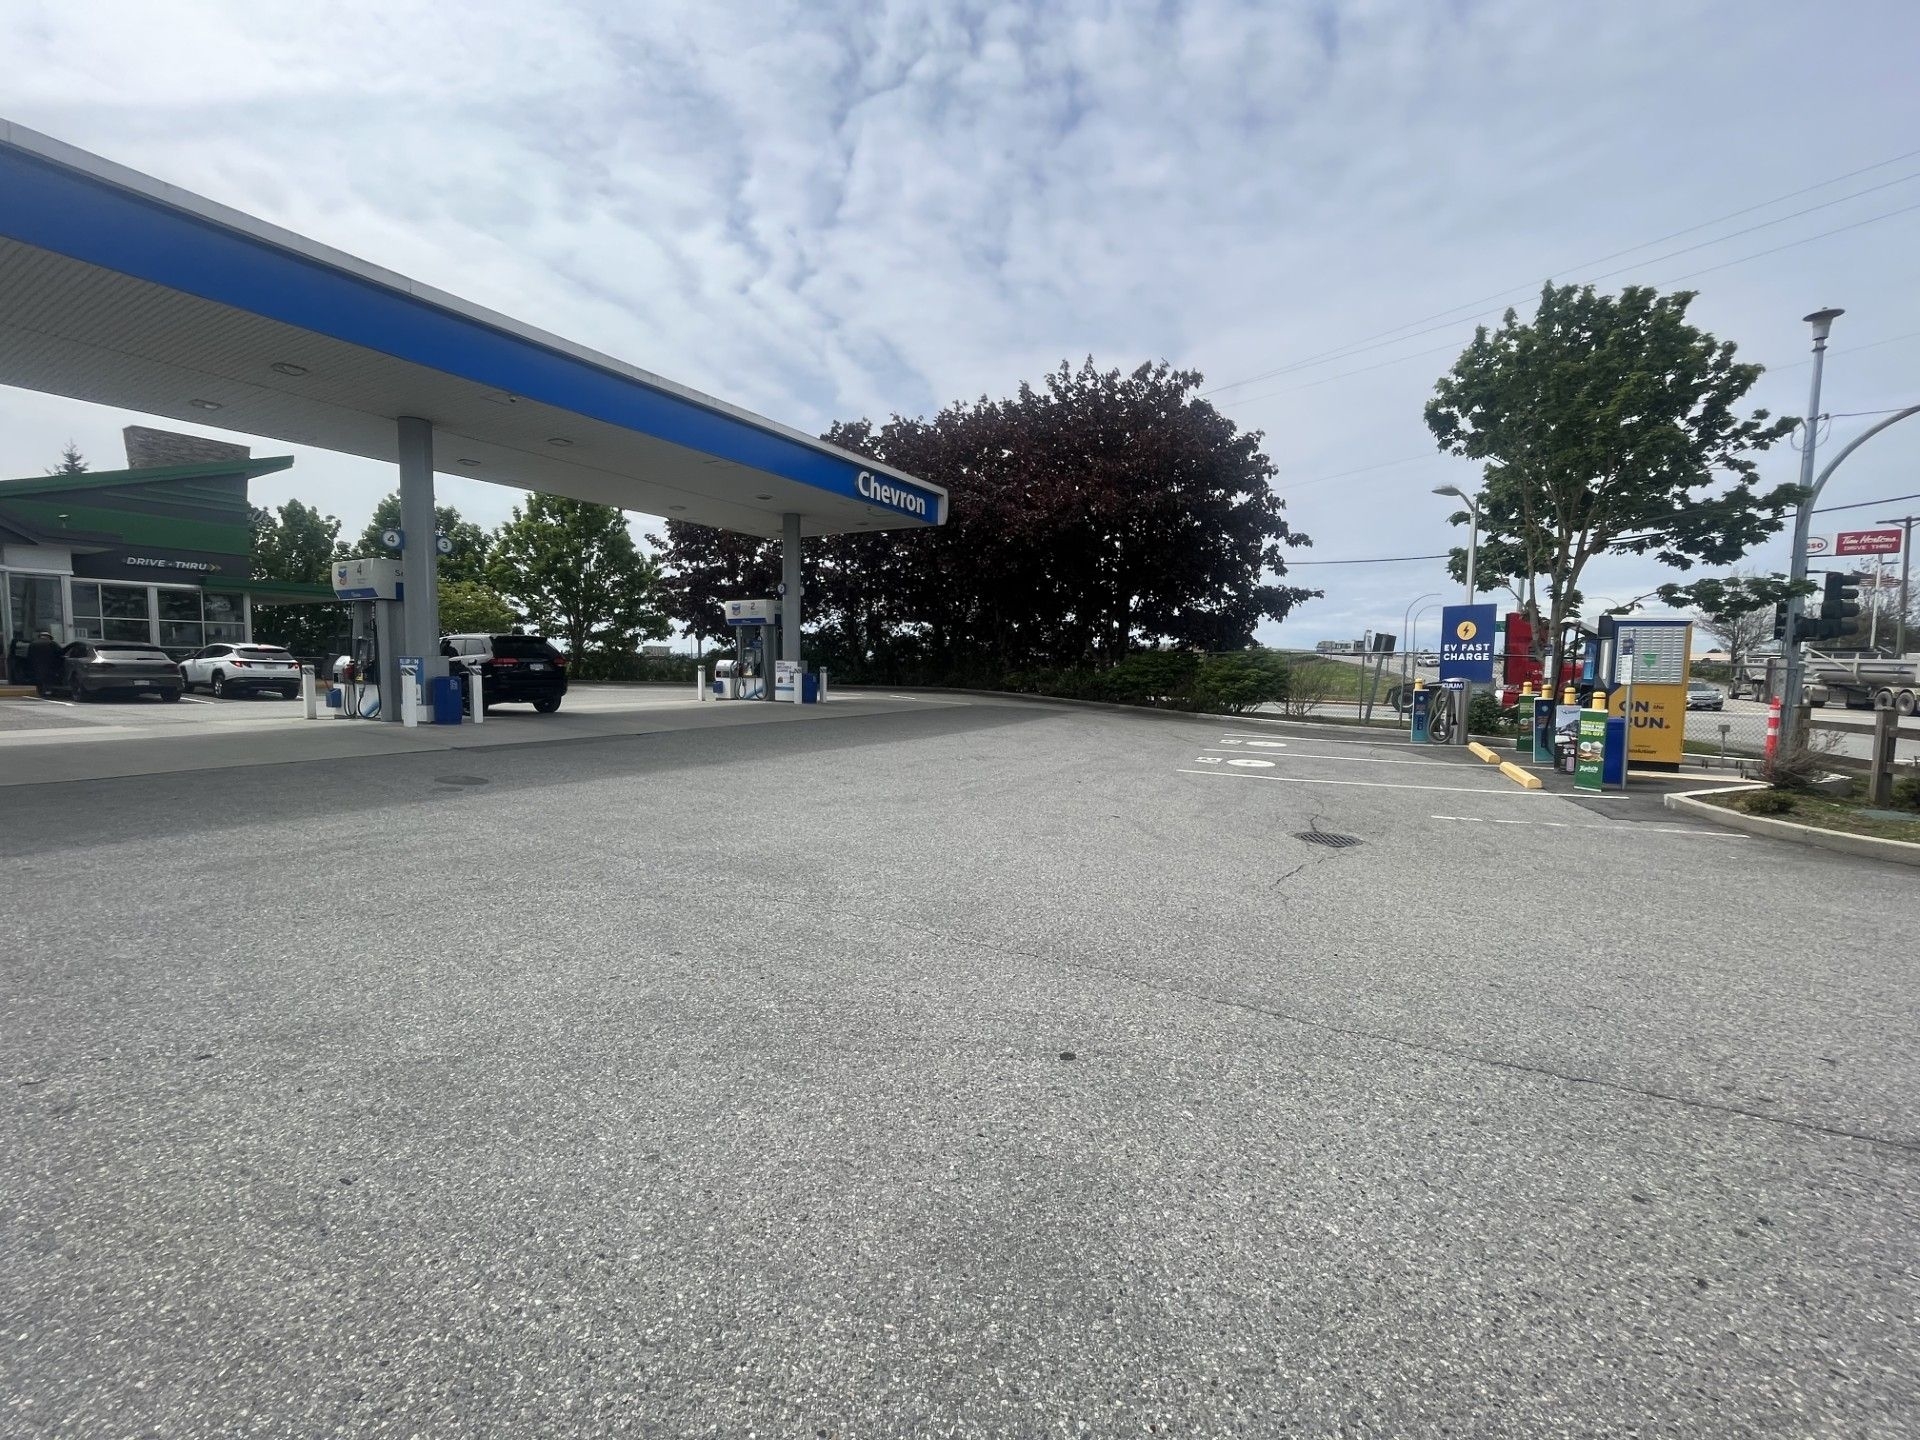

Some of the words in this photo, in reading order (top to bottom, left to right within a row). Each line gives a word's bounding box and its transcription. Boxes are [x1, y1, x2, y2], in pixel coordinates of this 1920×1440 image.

[857, 471, 926, 515] Chevron
[387, 534, 396, 544] 4
[1842, 536, 1859, 544] Tim
[1859, 534, 1897, 544] Hortons
[441, 541, 449, 550] 3
[126, 556, 166, 568] DRIVE
[175, 561, 207, 571] THRU
[356, 563, 362, 576] 4
[750, 602, 756, 610] 2
[1444, 644, 1458, 652] EV
[1461, 643, 1490, 651] FAST
[1443, 652, 1490, 661] CHARGE
[1618, 700, 1649, 713] ON
